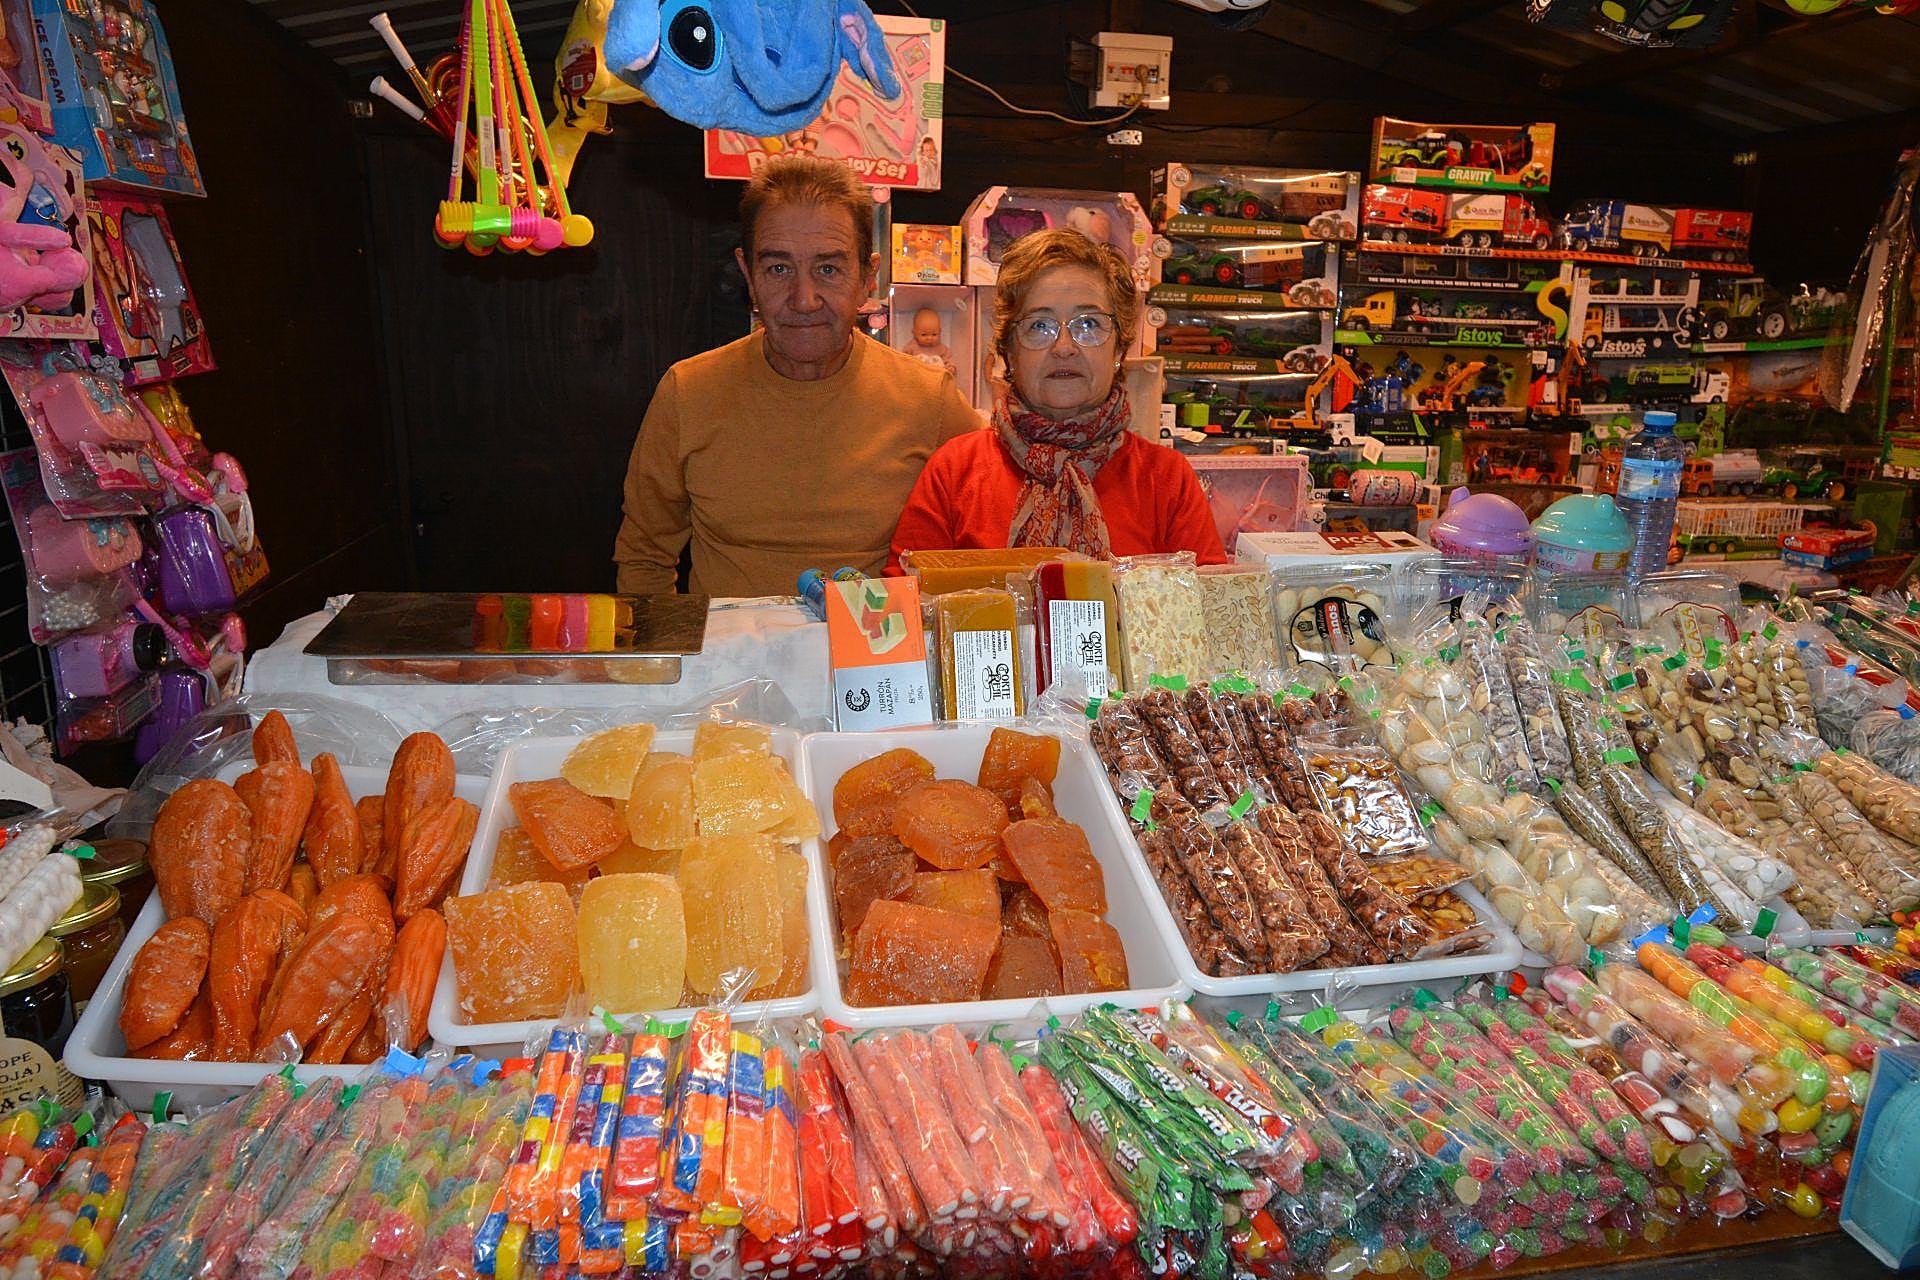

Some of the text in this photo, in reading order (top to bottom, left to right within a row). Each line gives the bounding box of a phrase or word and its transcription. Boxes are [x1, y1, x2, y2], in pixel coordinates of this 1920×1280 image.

[34, 18, 66, 104] ICE CREAM
[1448, 168, 1492, 182] GRAVITY
[1210, 224, 1256, 234] FARMER
[1256, 228, 1282, 236] TRUCK
[1192, 293, 1237, 303] FARMER
[1237, 296, 1263, 304] TRUCK
[1186, 360, 1231, 370] FARMER
[1231, 363, 1257, 371] TRUCK
[1784, 536, 1803, 549] Orbit
[1328, 604, 1341, 636] anos
[1089, 631, 1103, 666] CORTE
[876, 681, 887, 713] TURRÓN
[884, 677, 895, 715] MAZAPÁN
[996, 663, 1011, 700] CORTE
